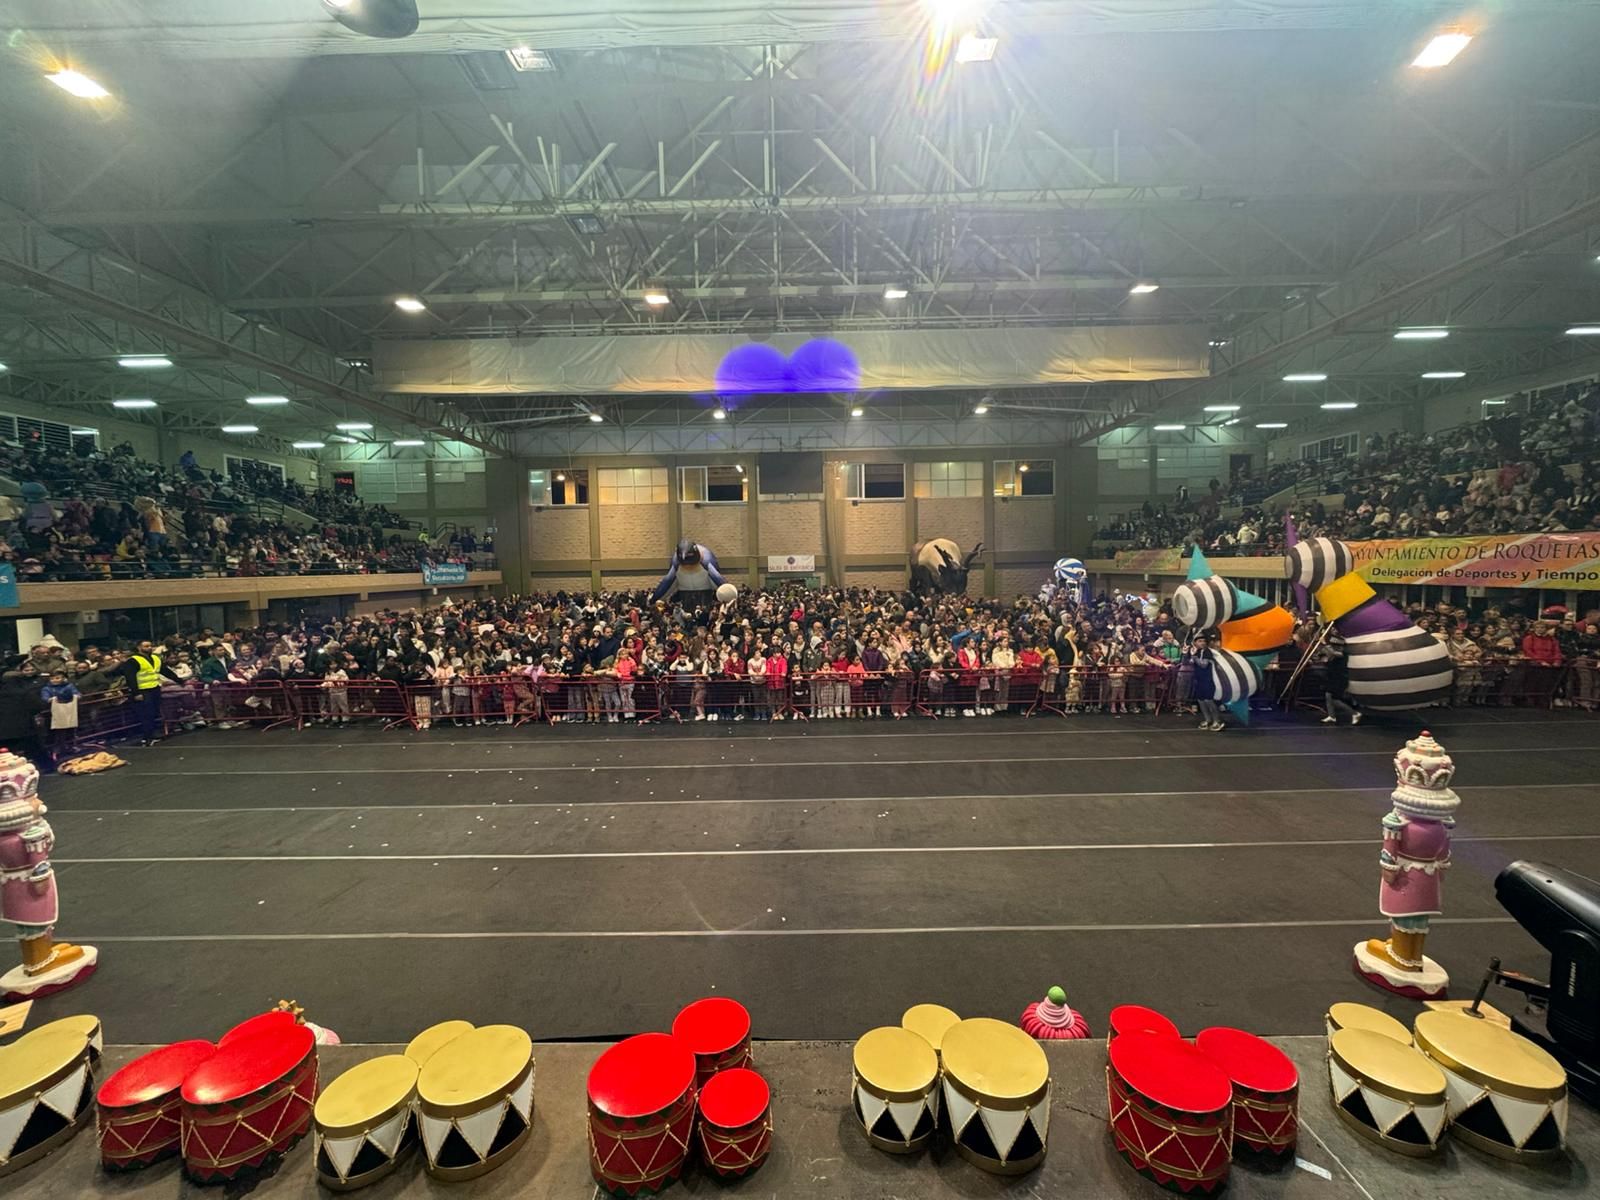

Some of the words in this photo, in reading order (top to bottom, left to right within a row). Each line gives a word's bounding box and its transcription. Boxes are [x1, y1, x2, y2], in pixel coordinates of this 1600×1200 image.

[1353, 545, 1460, 561] AYUNTAMIENTO
[1464, 545, 1487, 560] DE
[1493, 542, 1600, 562] ROQUETAS
[1372, 567, 1433, 579] Delegación
[1436, 568, 1451, 578] de
[1455, 568, 1517, 580] Deportes
[1522, 571, 1531, 582] y
[1536, 569, 1599, 583] Tiempo
